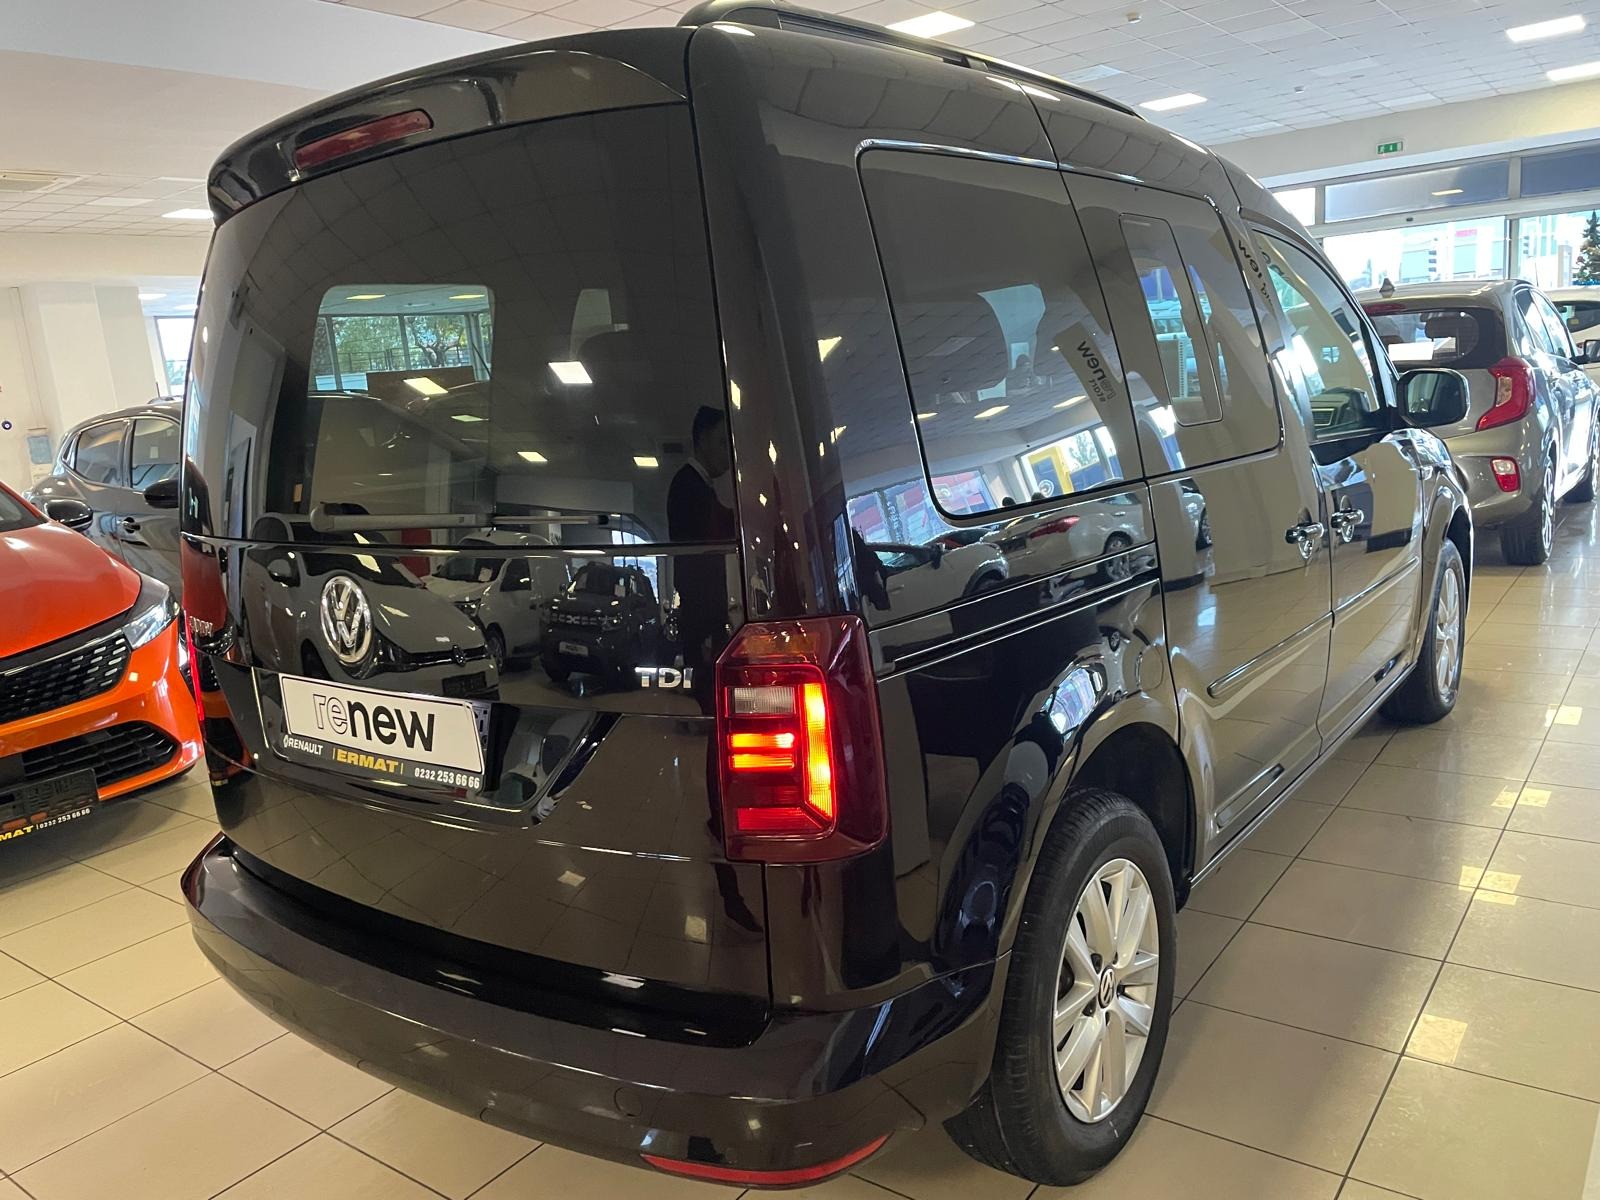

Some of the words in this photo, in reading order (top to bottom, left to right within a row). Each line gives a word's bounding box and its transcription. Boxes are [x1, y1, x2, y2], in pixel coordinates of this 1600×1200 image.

[634, 666, 693, 688] TDI
[312, 693, 435, 752] renew
[288, 738, 323, 755] RENAULT
[336, 748, 399, 773] ERMAT
[414, 767, 436, 781] 0232
[436, 769, 455, 784] 253
[455, 773, 468, 787] 66
[468, 776, 480, 789] 66
